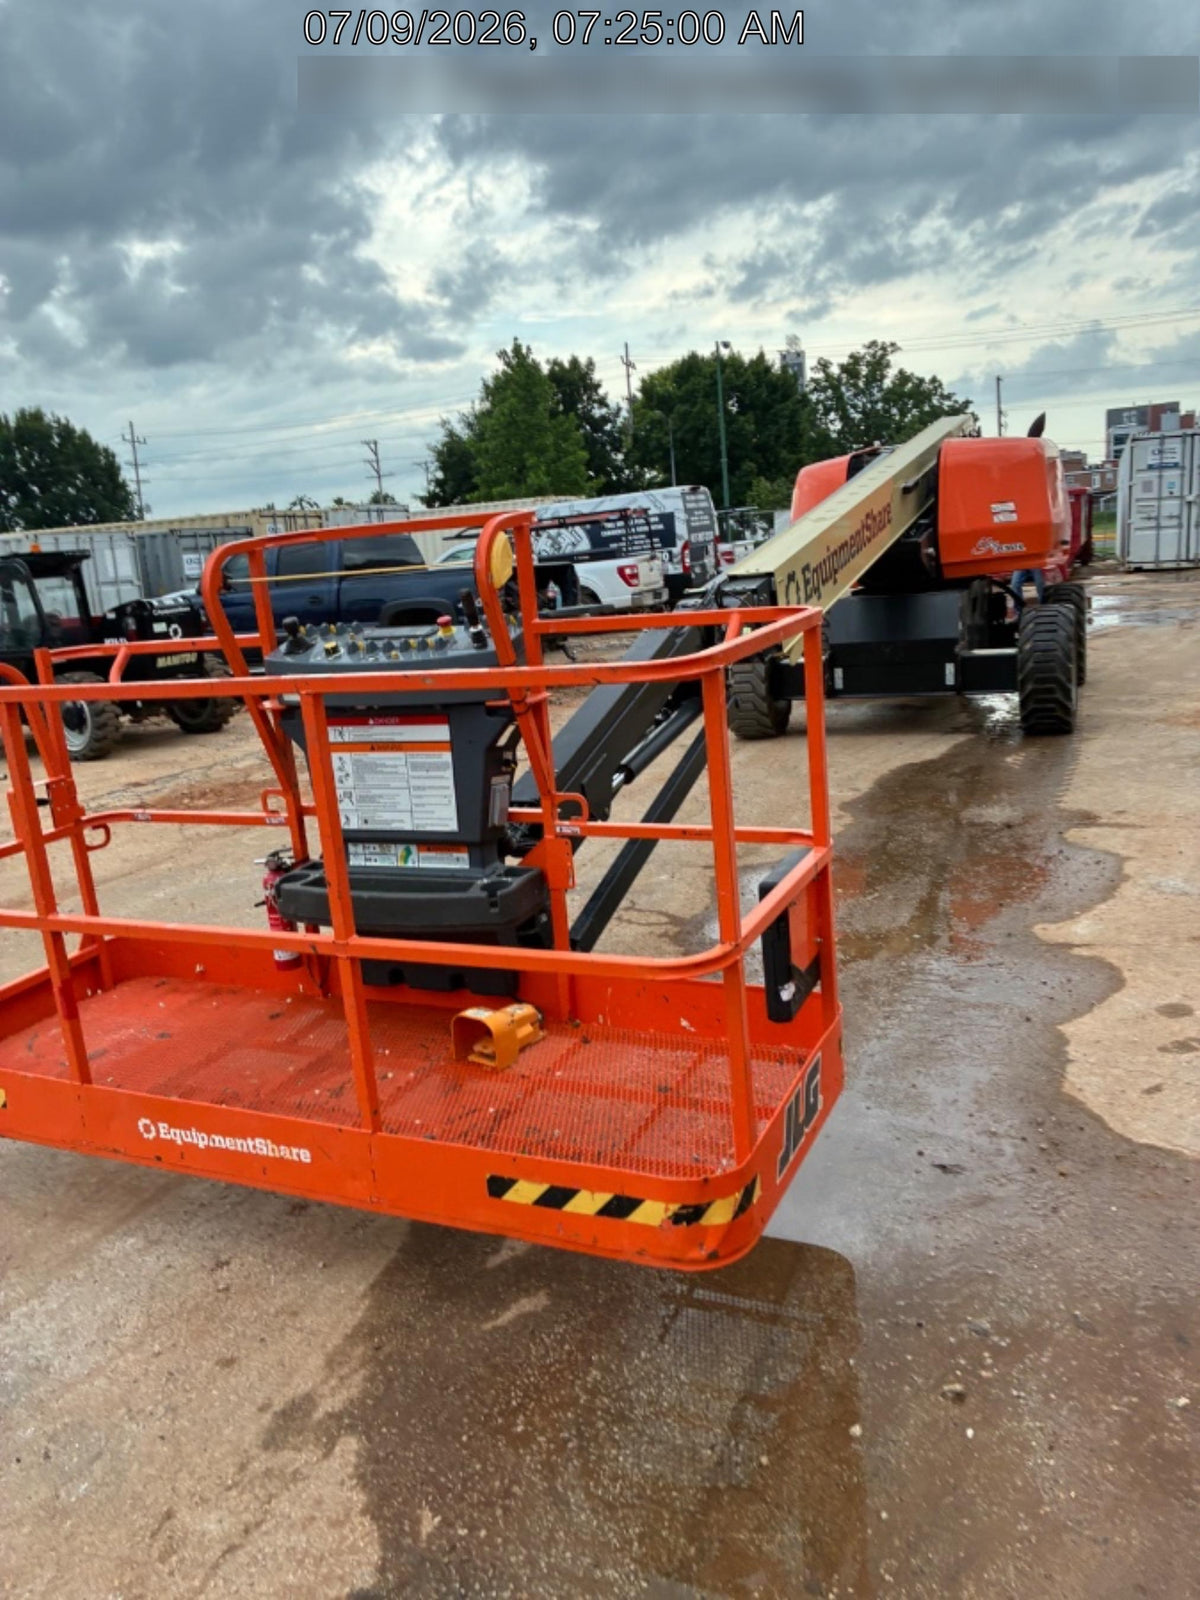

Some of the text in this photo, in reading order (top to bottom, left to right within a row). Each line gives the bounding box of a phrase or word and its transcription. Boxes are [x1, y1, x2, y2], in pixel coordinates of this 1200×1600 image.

[801, 502, 892, 604] EquipmentShare
[157, 1122, 312, 1164] EquipmentShare
[776, 1050, 823, 1185] JLG
